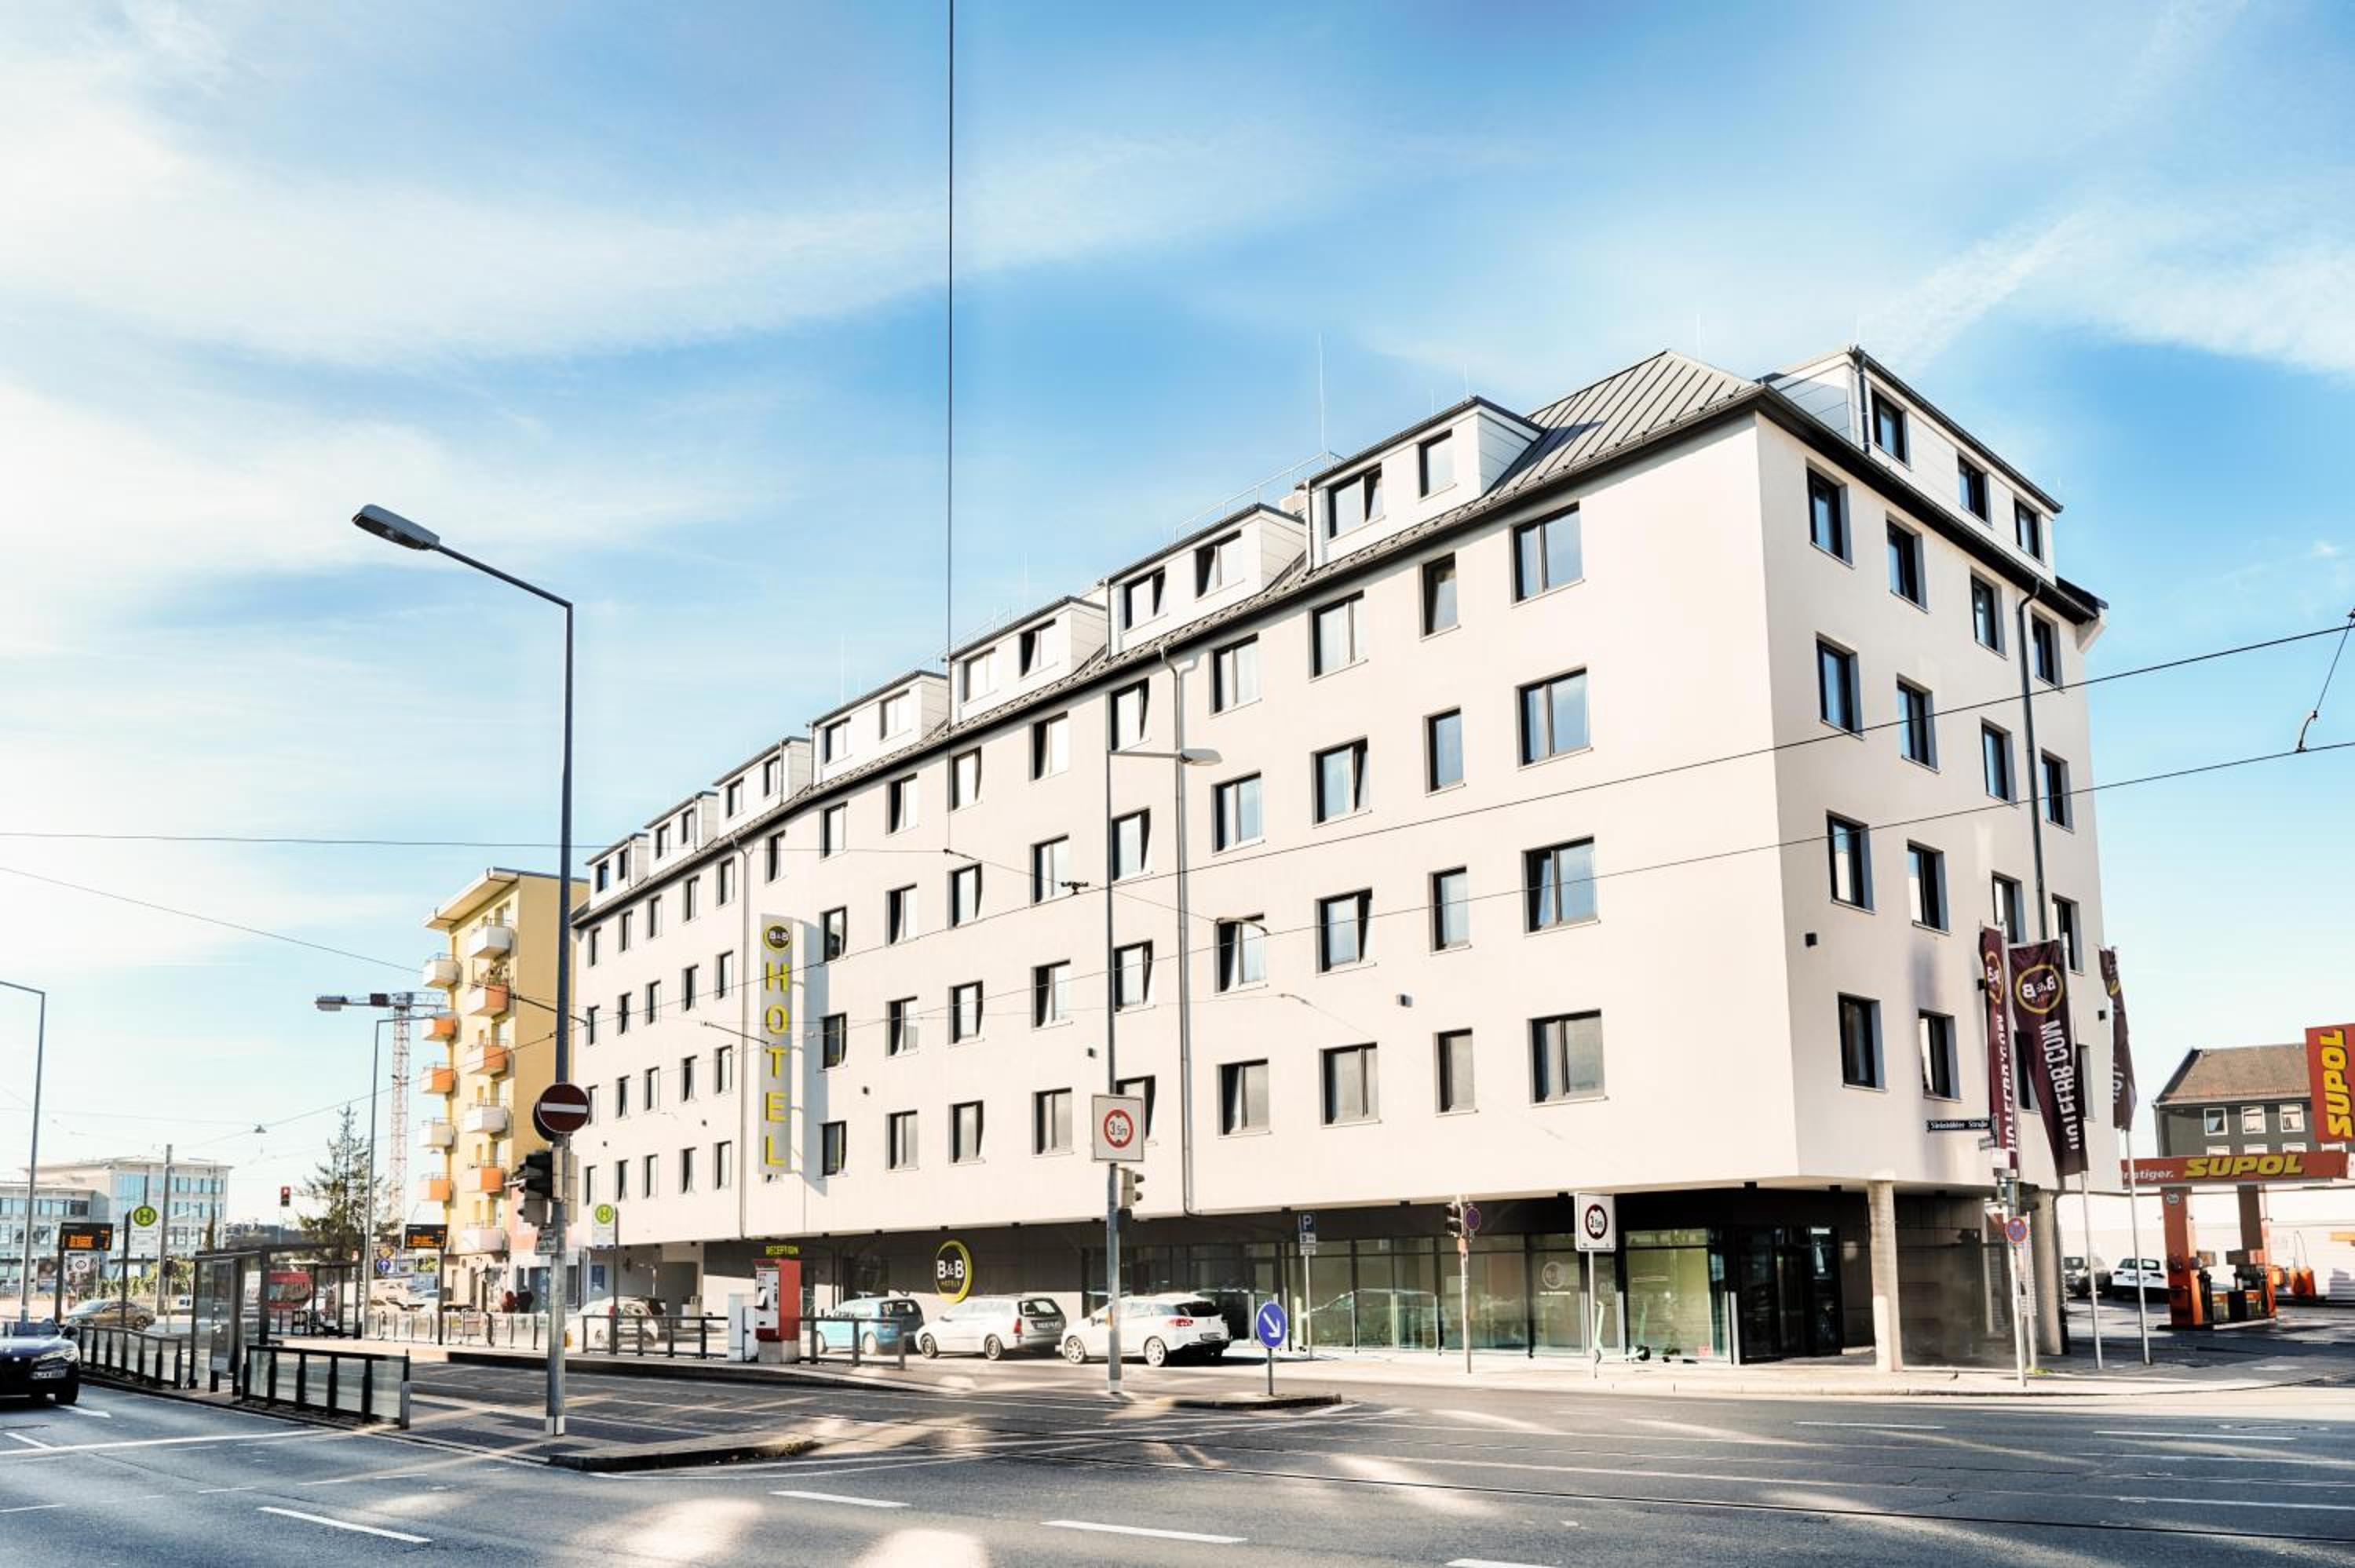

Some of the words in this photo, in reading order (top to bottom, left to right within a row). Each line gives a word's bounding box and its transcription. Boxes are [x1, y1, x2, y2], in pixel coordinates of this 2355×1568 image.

[765, 961, 789, 1165] HOTEL
[2319, 1029, 2353, 1138] SUPOL
[2185, 1154, 2303, 1177] SUPOL
[1303, 1214, 1312, 1231] P
[766, 1245, 799, 1256] RECEPTION
[937, 1260, 964, 1279] B&B
